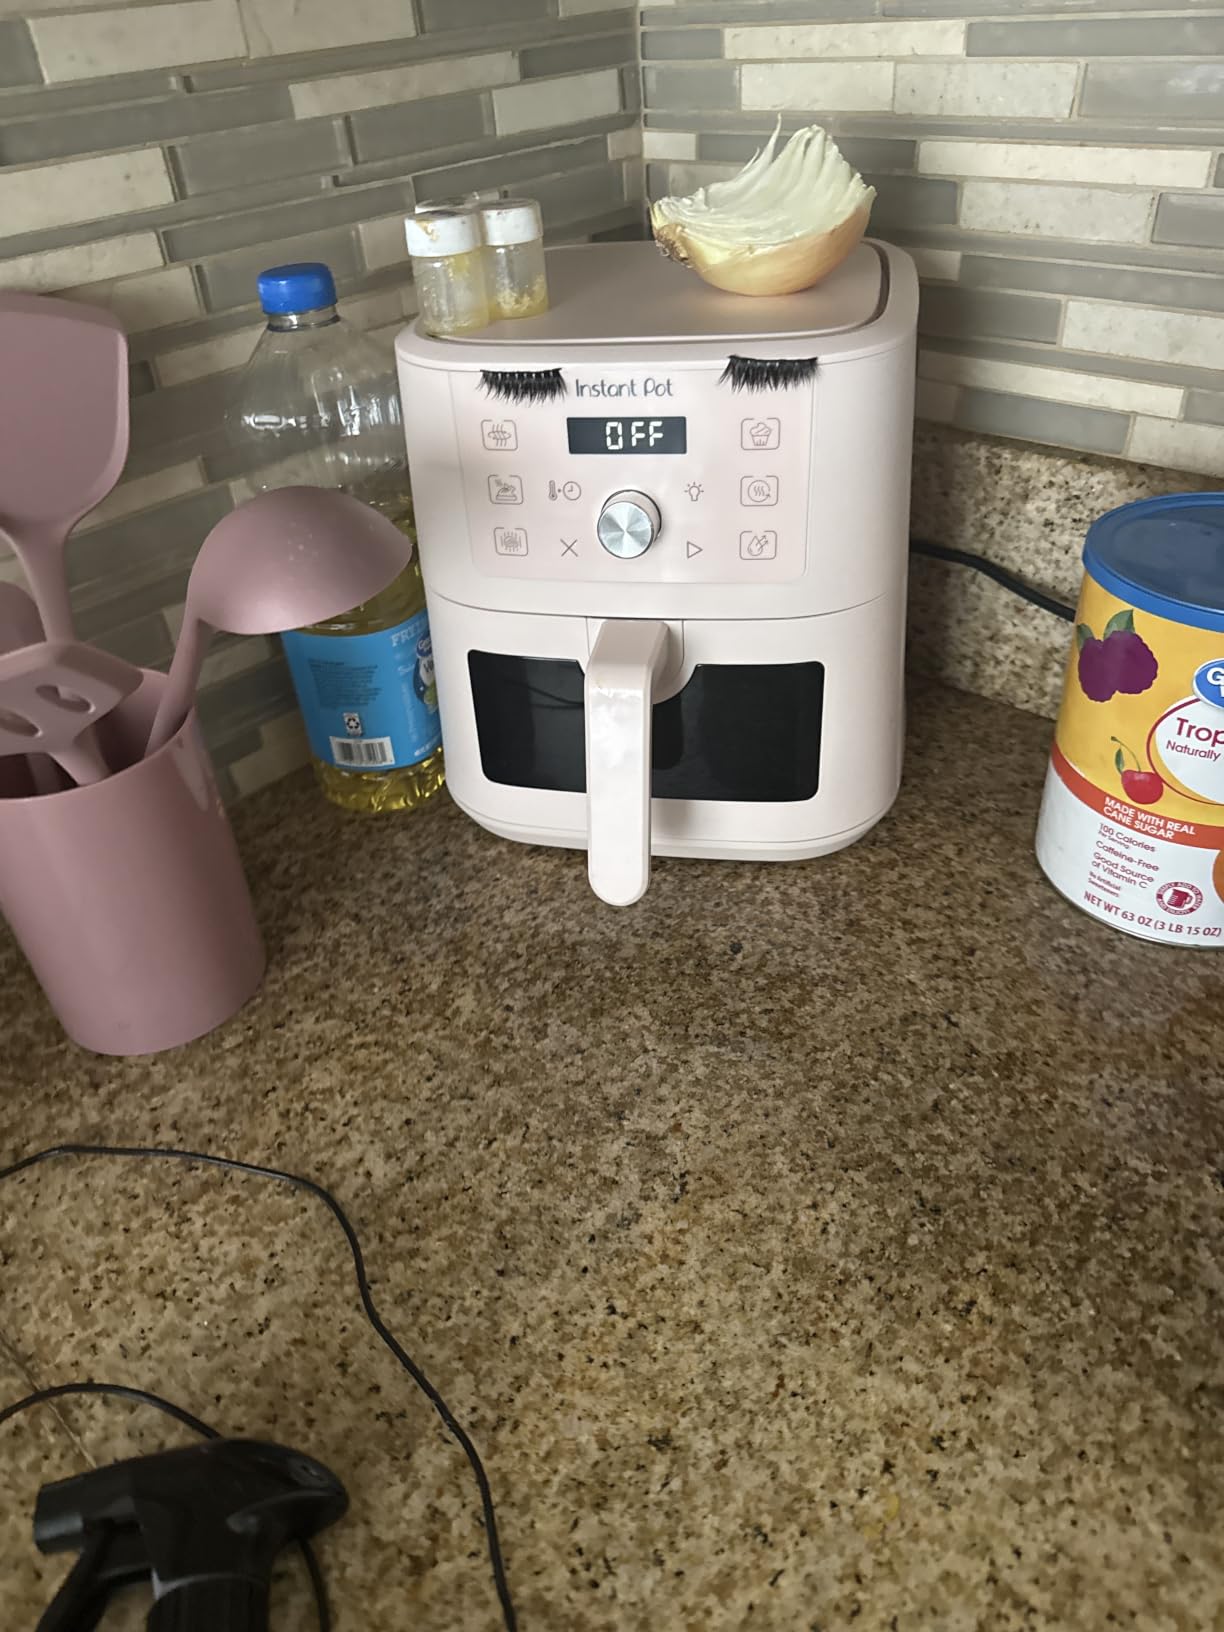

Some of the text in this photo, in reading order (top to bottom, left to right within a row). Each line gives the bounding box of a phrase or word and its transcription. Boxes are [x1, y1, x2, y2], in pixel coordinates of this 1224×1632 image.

[576, 377, 674, 398] Instant Pot
[606, 421, 664, 450] OFF
[1166, 740, 1221, 762] Naturally
[1103, 806, 1175, 839] CANE SUGAR
[1104, 796, 1196, 835] MADE WITH REAL
[1099, 822, 1157, 853] 100 Calories
[1093, 851, 1155, 883] Good Source
[1095, 840, 1160, 872] Caffeine-Free
[1091, 860, 1149, 889] of Vitamin C
[1083, 890, 1222, 938] NET WT 63 OZ (3 LB 15 OZ)
